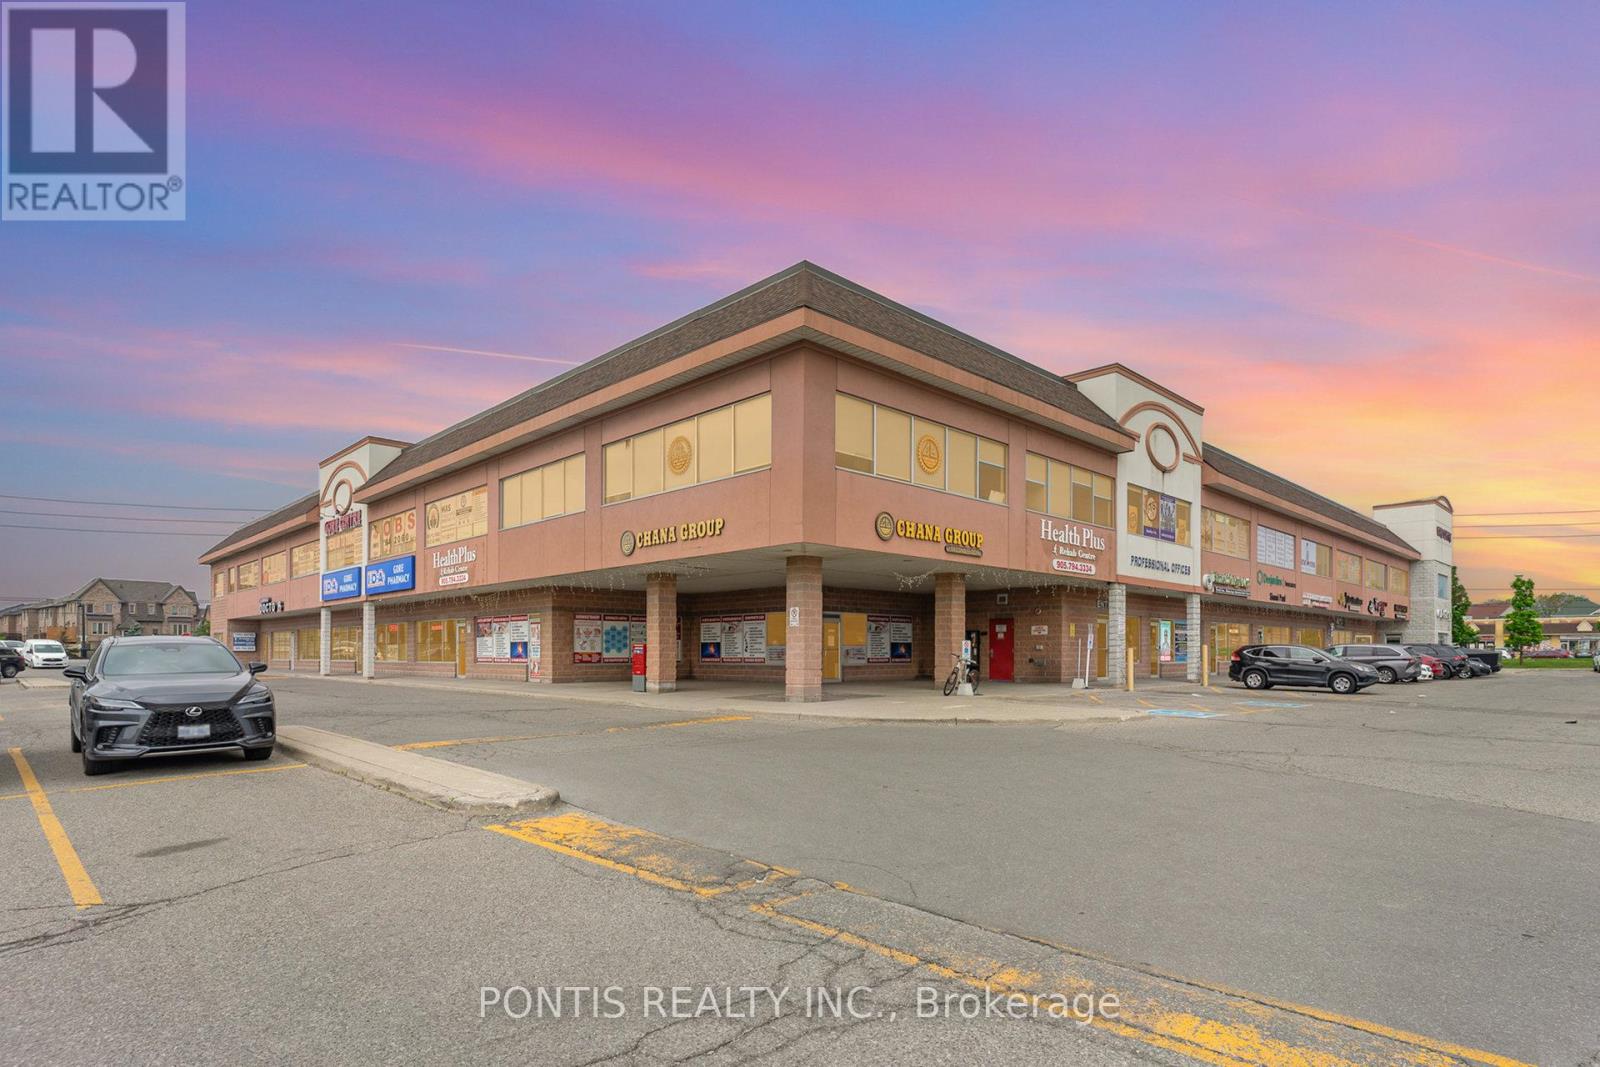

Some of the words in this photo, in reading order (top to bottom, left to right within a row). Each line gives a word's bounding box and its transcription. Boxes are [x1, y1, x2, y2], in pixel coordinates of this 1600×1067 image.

[636, 526, 677, 549] CHANA
[680, 517, 725, 541] GROUP
[896, 519, 941, 543] CHANA
[944, 527, 984, 548] GROUP
[1040, 518, 1081, 547] Health
[1081, 527, 1106, 551] Plus
[432, 548, 459, 569] Health
[458, 545, 477, 564] Plus
[1078, 549, 1097, 561] Centre
[1130, 555, 1170, 572] PROFESSIONAL
[1171, 562, 1191, 576] OFFICES
[387, 573, 410, 585] PHARMACY
